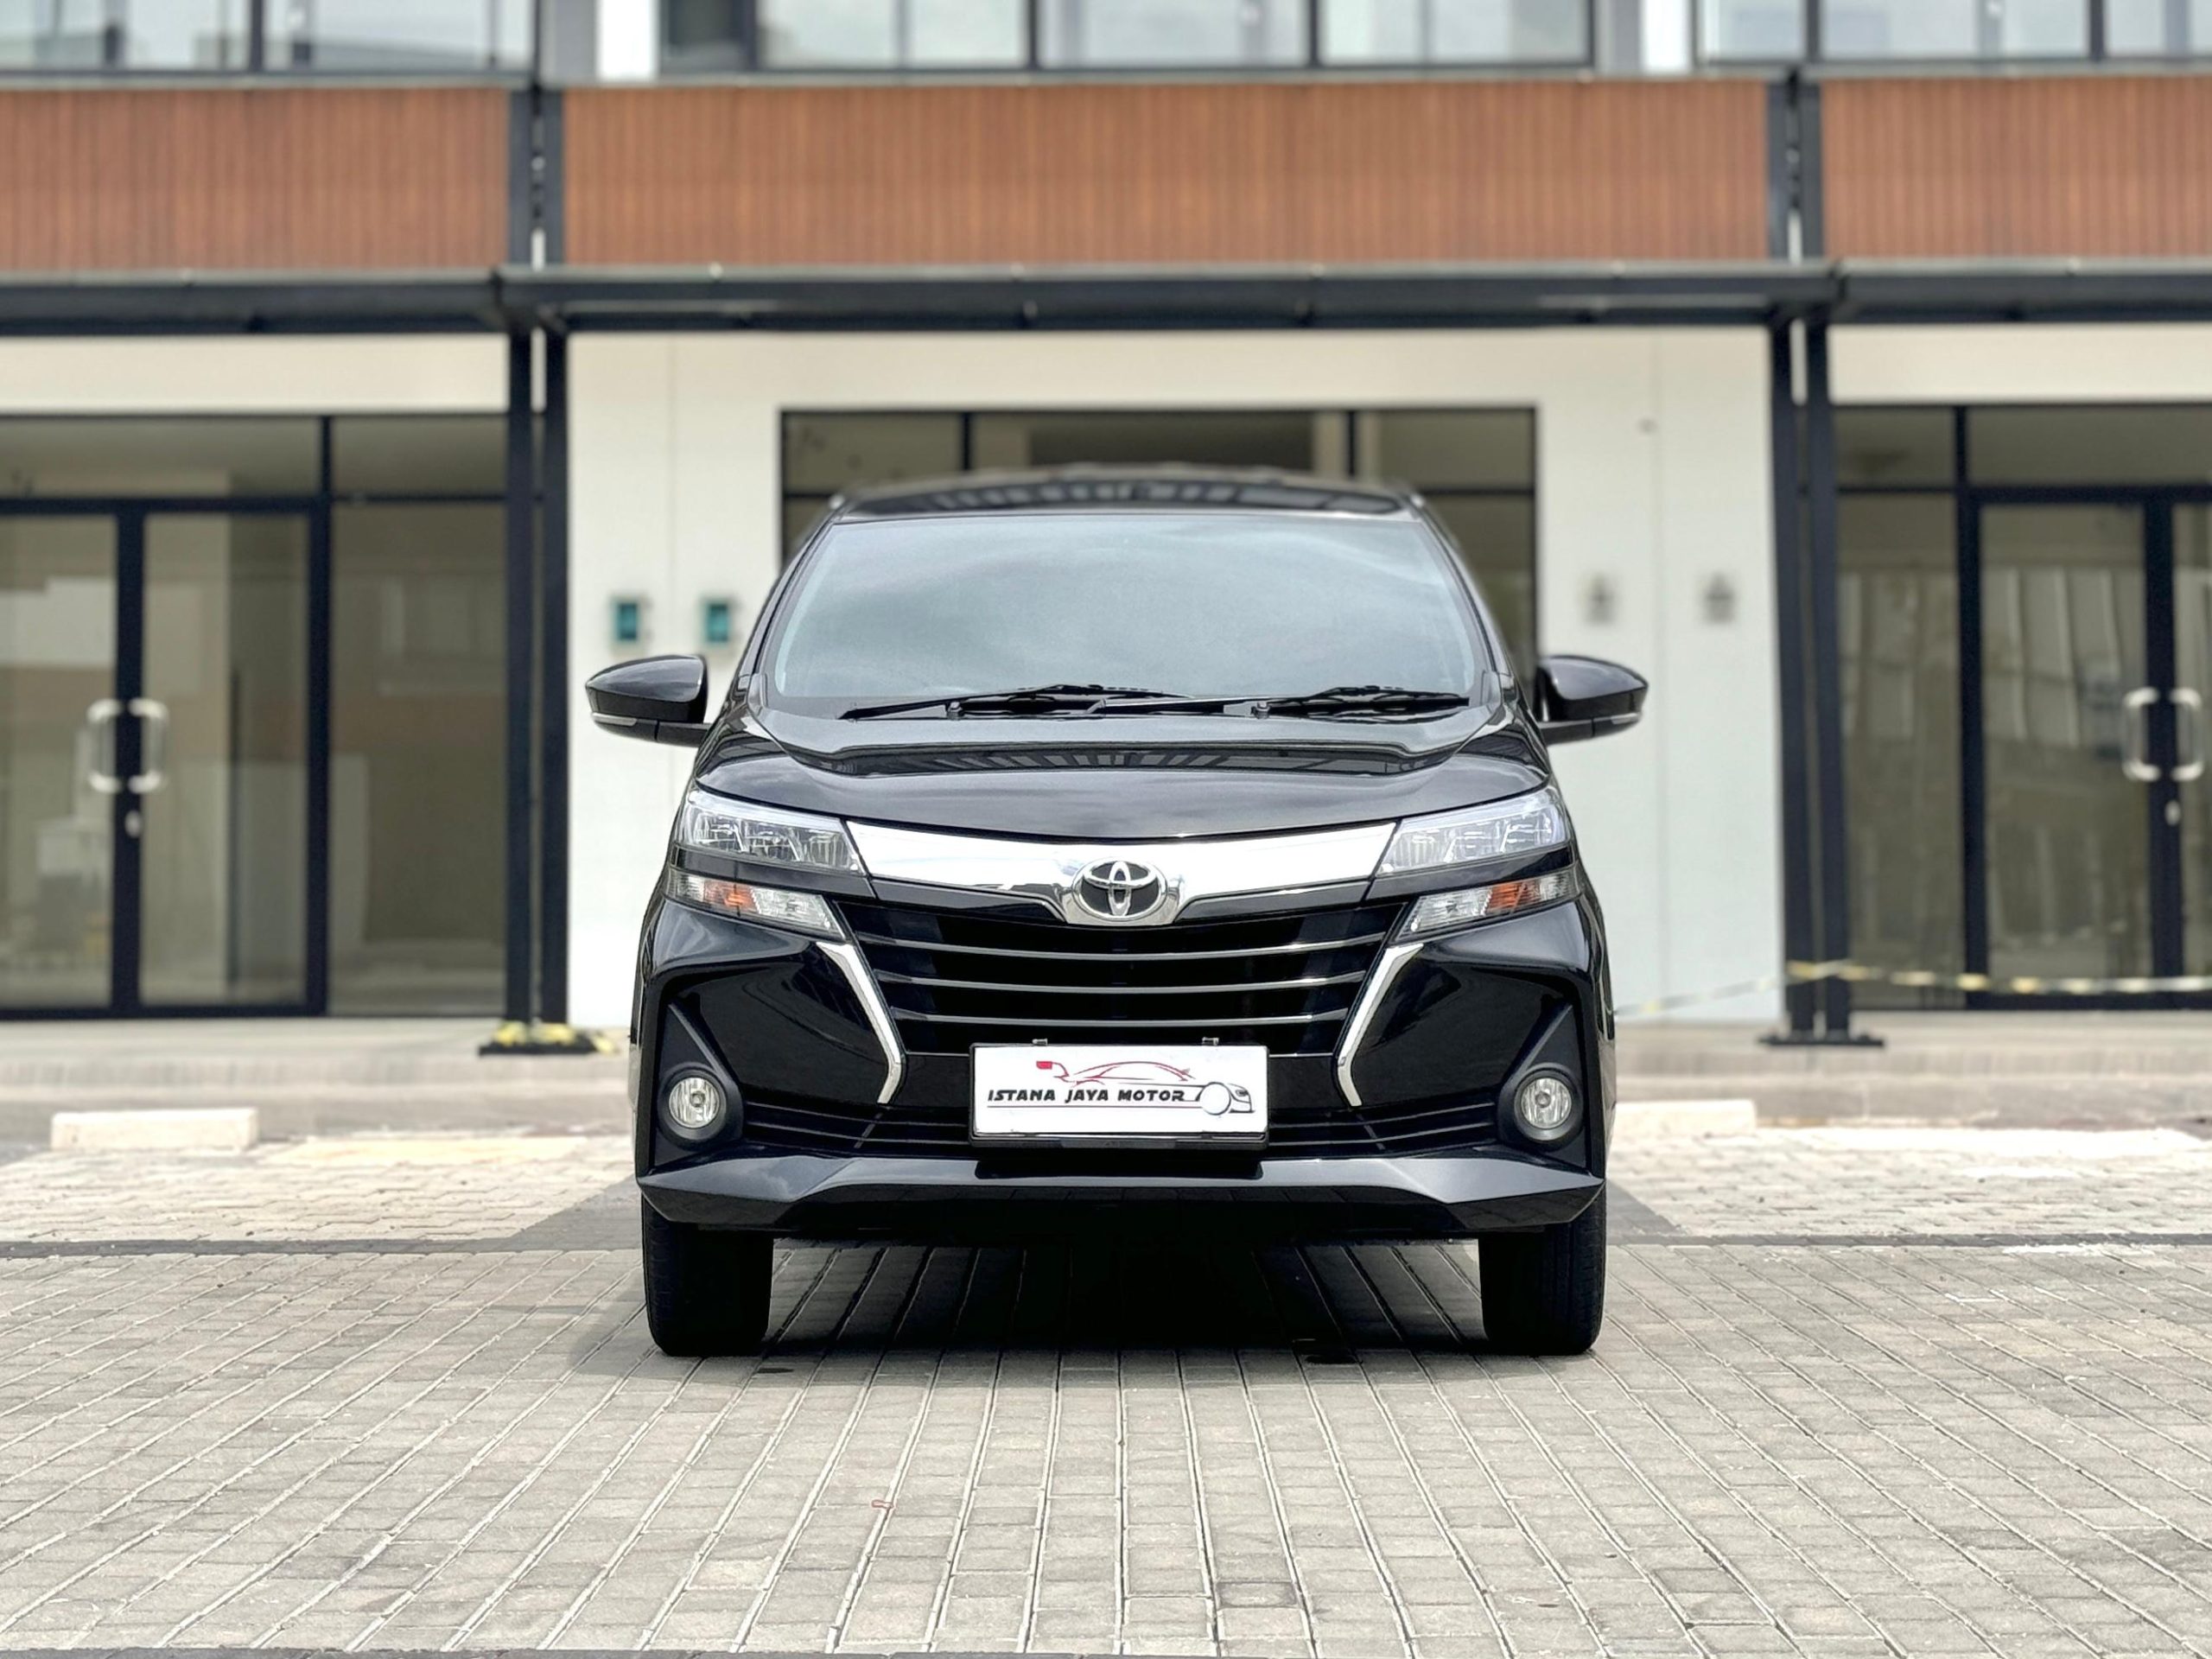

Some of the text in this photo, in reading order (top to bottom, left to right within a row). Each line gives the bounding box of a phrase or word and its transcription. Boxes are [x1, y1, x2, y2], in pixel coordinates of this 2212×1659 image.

[988, 1090, 1185, 1103] ISTANA JAYA MOTOR
